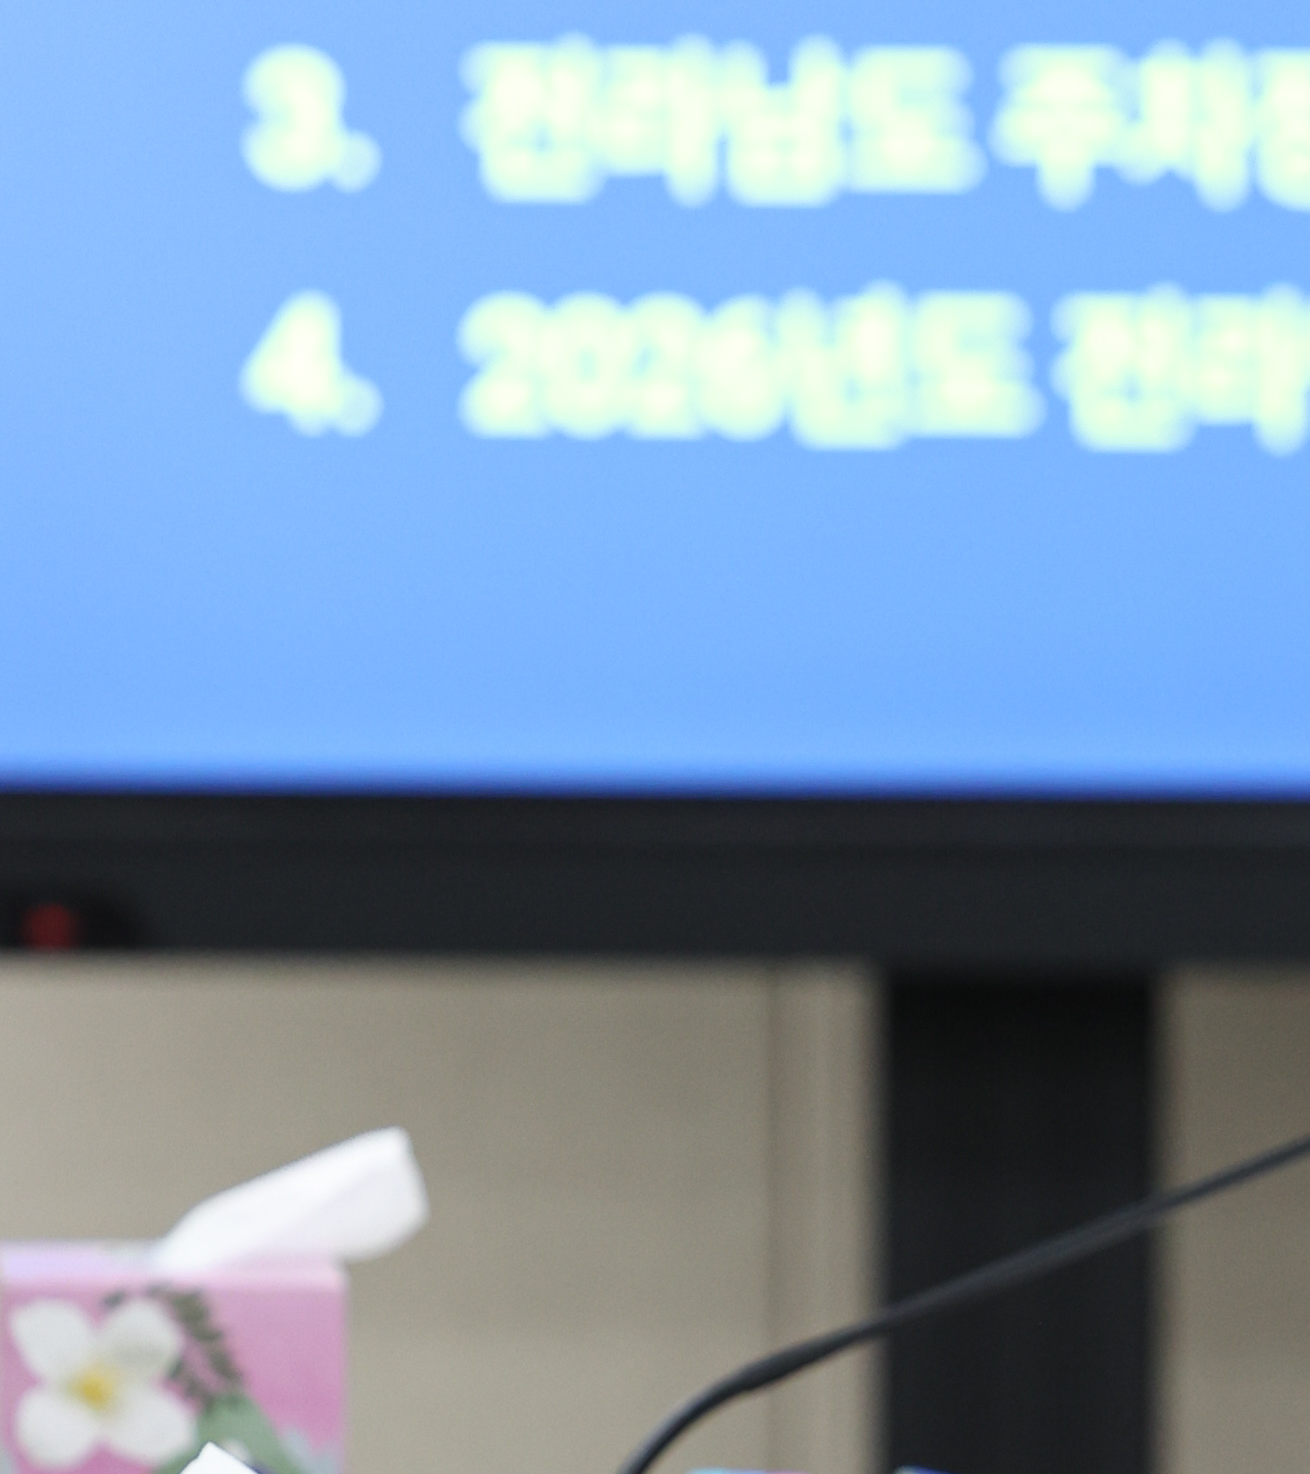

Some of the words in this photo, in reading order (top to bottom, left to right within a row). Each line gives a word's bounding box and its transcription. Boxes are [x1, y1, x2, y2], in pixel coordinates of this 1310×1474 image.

[244, 45, 379, 190] 3.
[463, 36, 980, 205] 전라남도
[241, 291, 380, 434] 4.
[459, 283, 1040, 448] 2026년도
